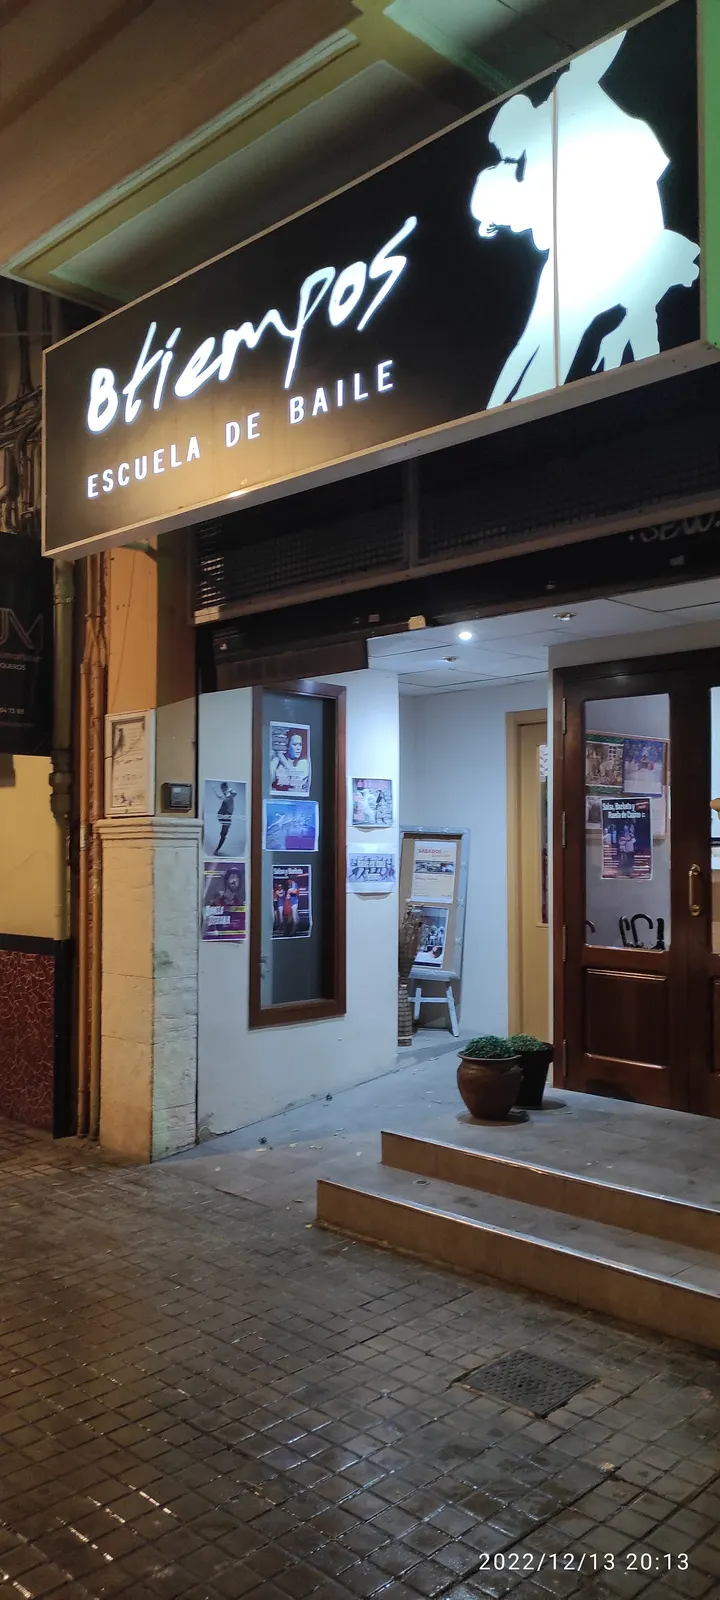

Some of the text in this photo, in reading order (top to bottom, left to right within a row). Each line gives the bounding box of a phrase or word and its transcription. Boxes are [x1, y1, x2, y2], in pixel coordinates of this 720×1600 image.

[87, 360, 393, 498] ESCUELA DE BAILE
